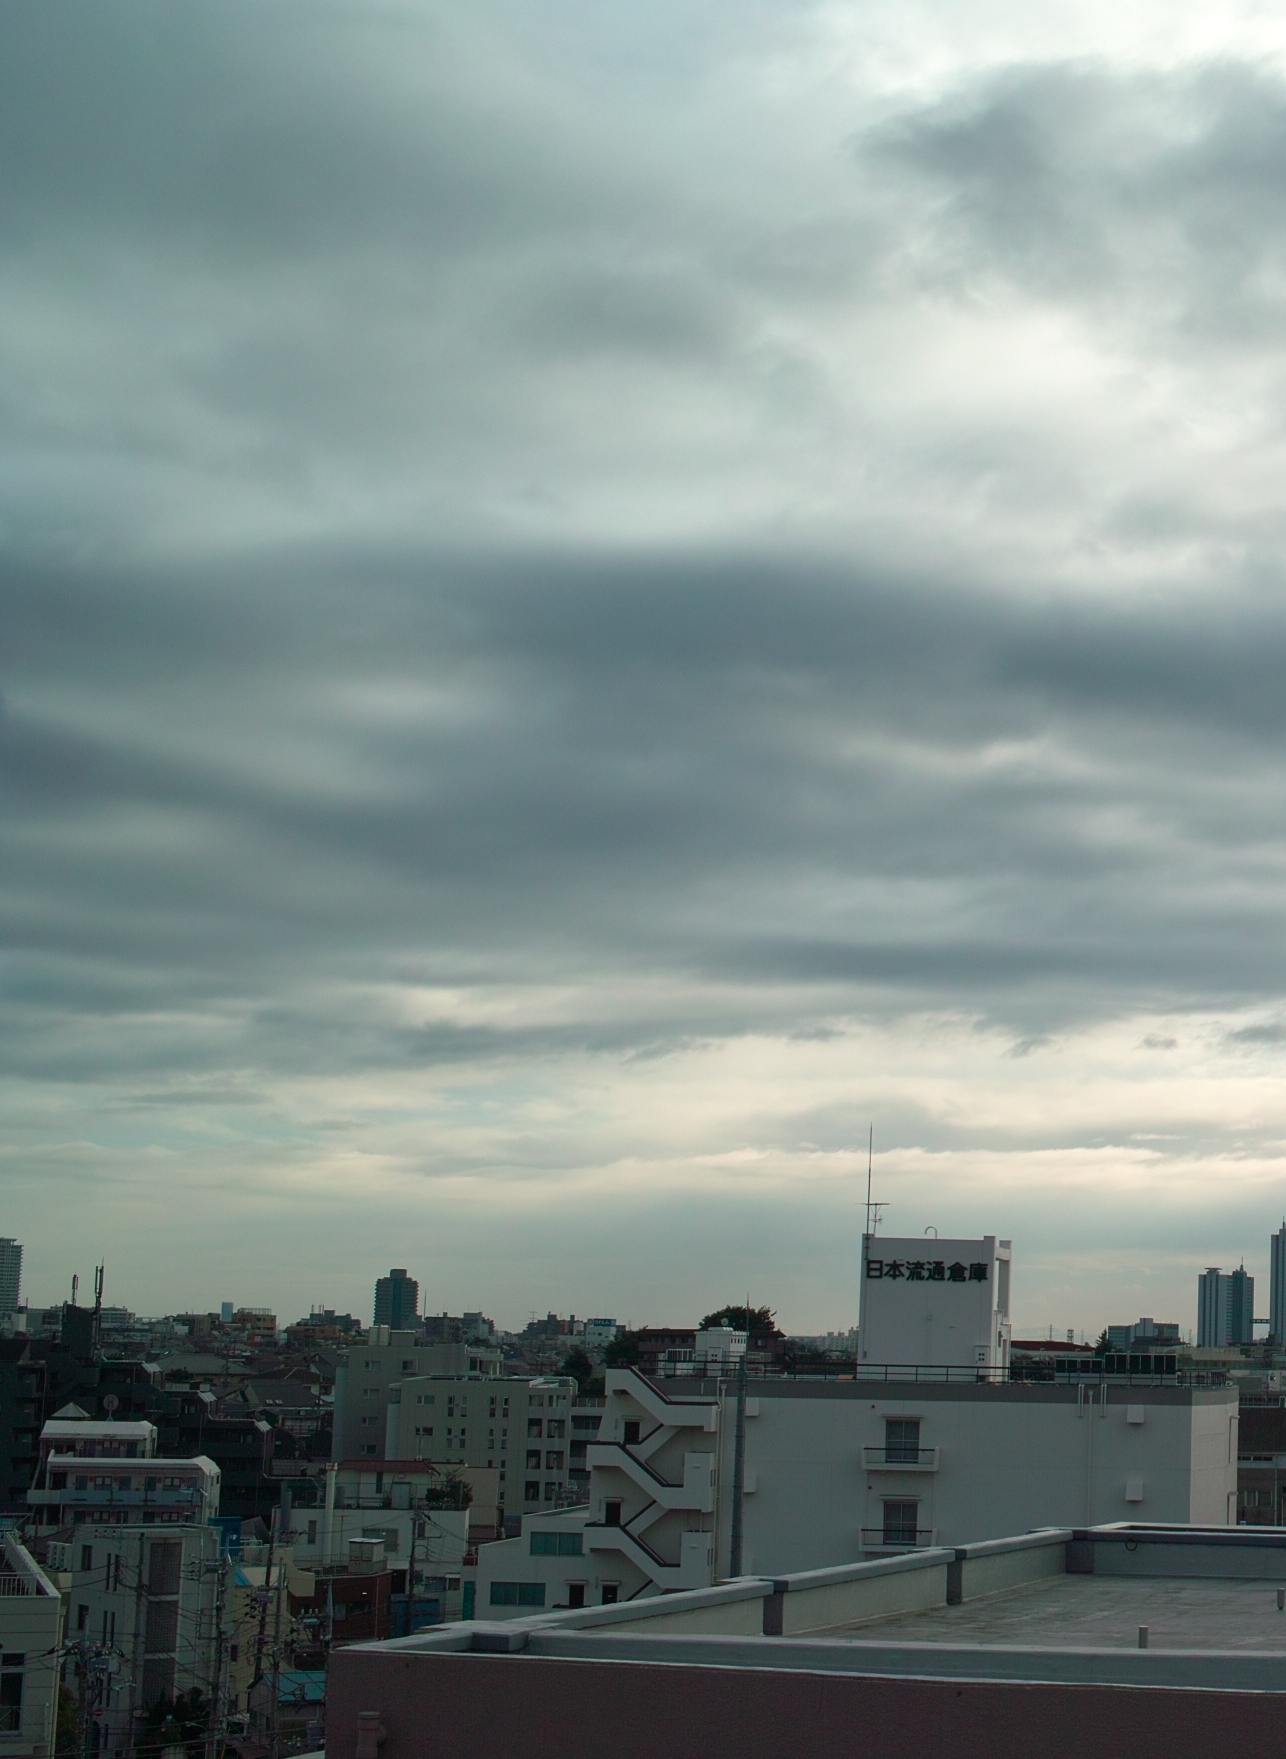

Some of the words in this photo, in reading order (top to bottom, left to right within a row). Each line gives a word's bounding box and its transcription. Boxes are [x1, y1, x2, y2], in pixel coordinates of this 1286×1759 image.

[866, 1260, 988, 1282] 日本流通倉庫
